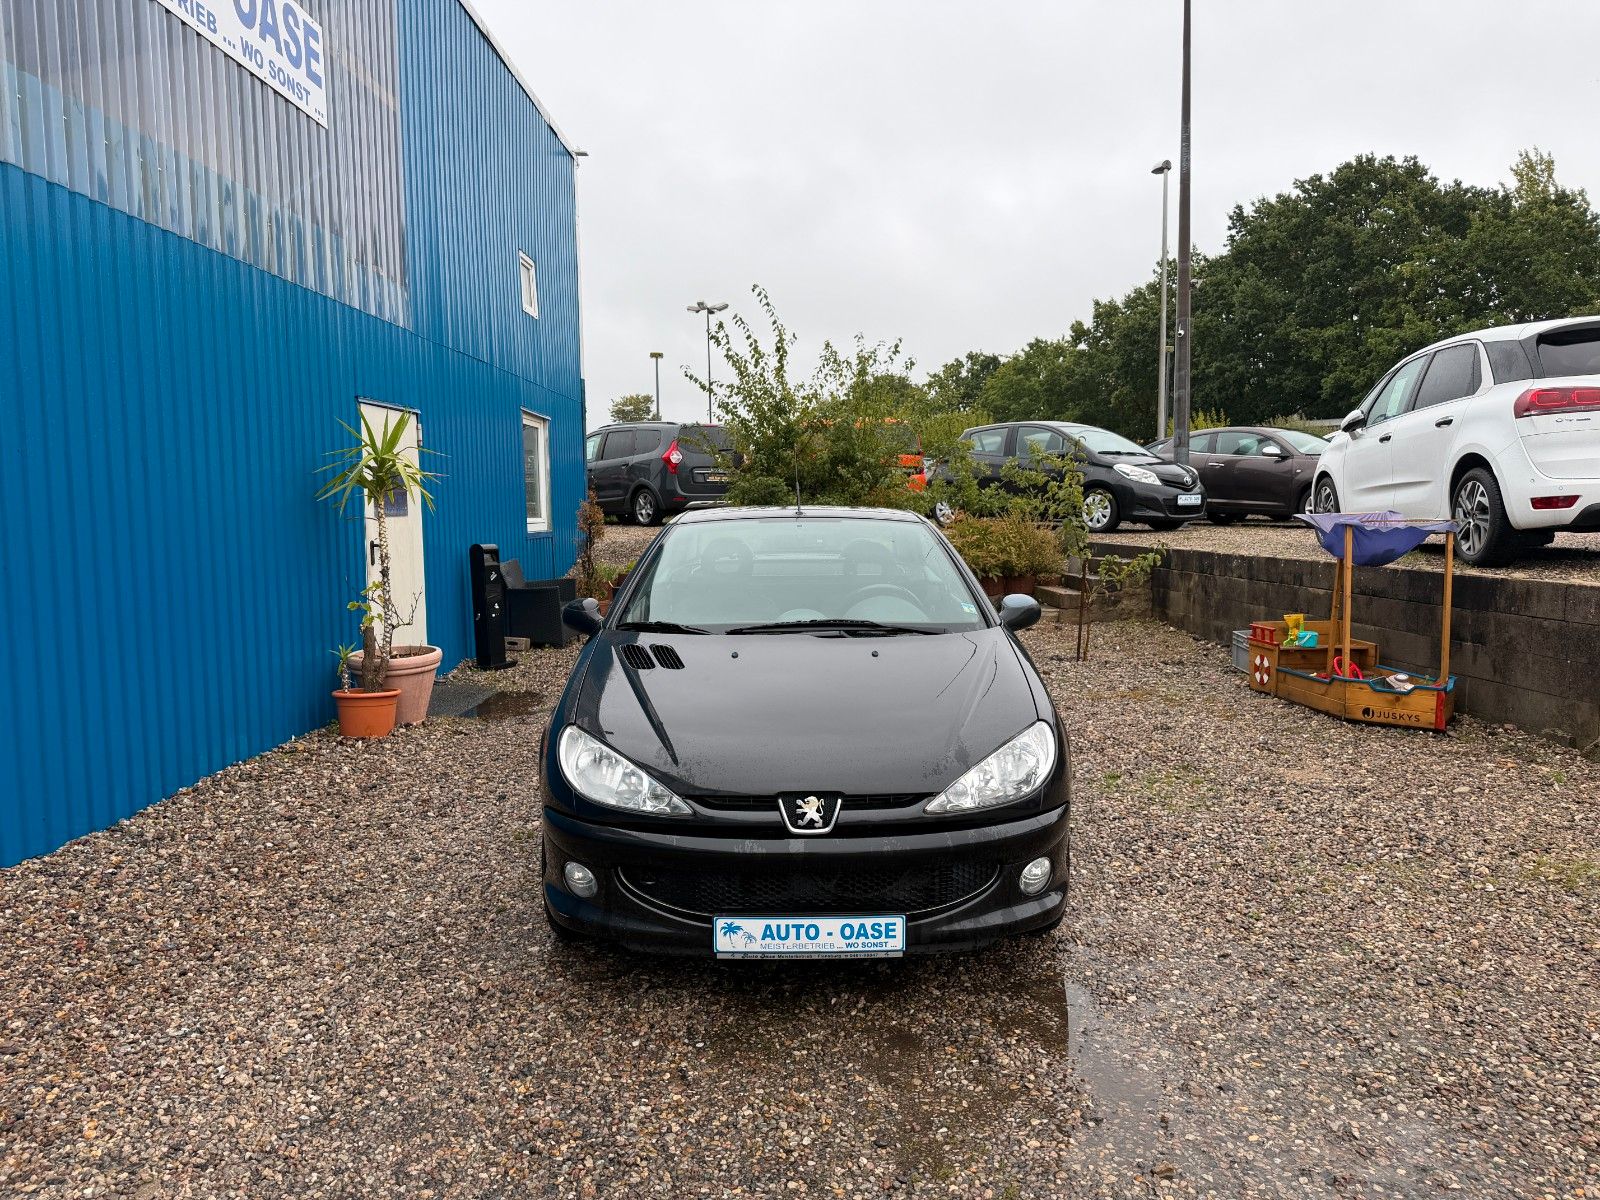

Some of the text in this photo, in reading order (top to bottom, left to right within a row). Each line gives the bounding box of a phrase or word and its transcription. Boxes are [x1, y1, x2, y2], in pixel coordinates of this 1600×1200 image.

[240, 35, 264, 70] WO
[268, 59, 311, 107] SONST
[1376, 710, 1421, 723] JUSKYS
[760, 923, 820, 941] AUTO
[839, 922, 897, 941] OASE
[845, 941, 860, 949] WO
[861, 941, 889, 949] SONST
